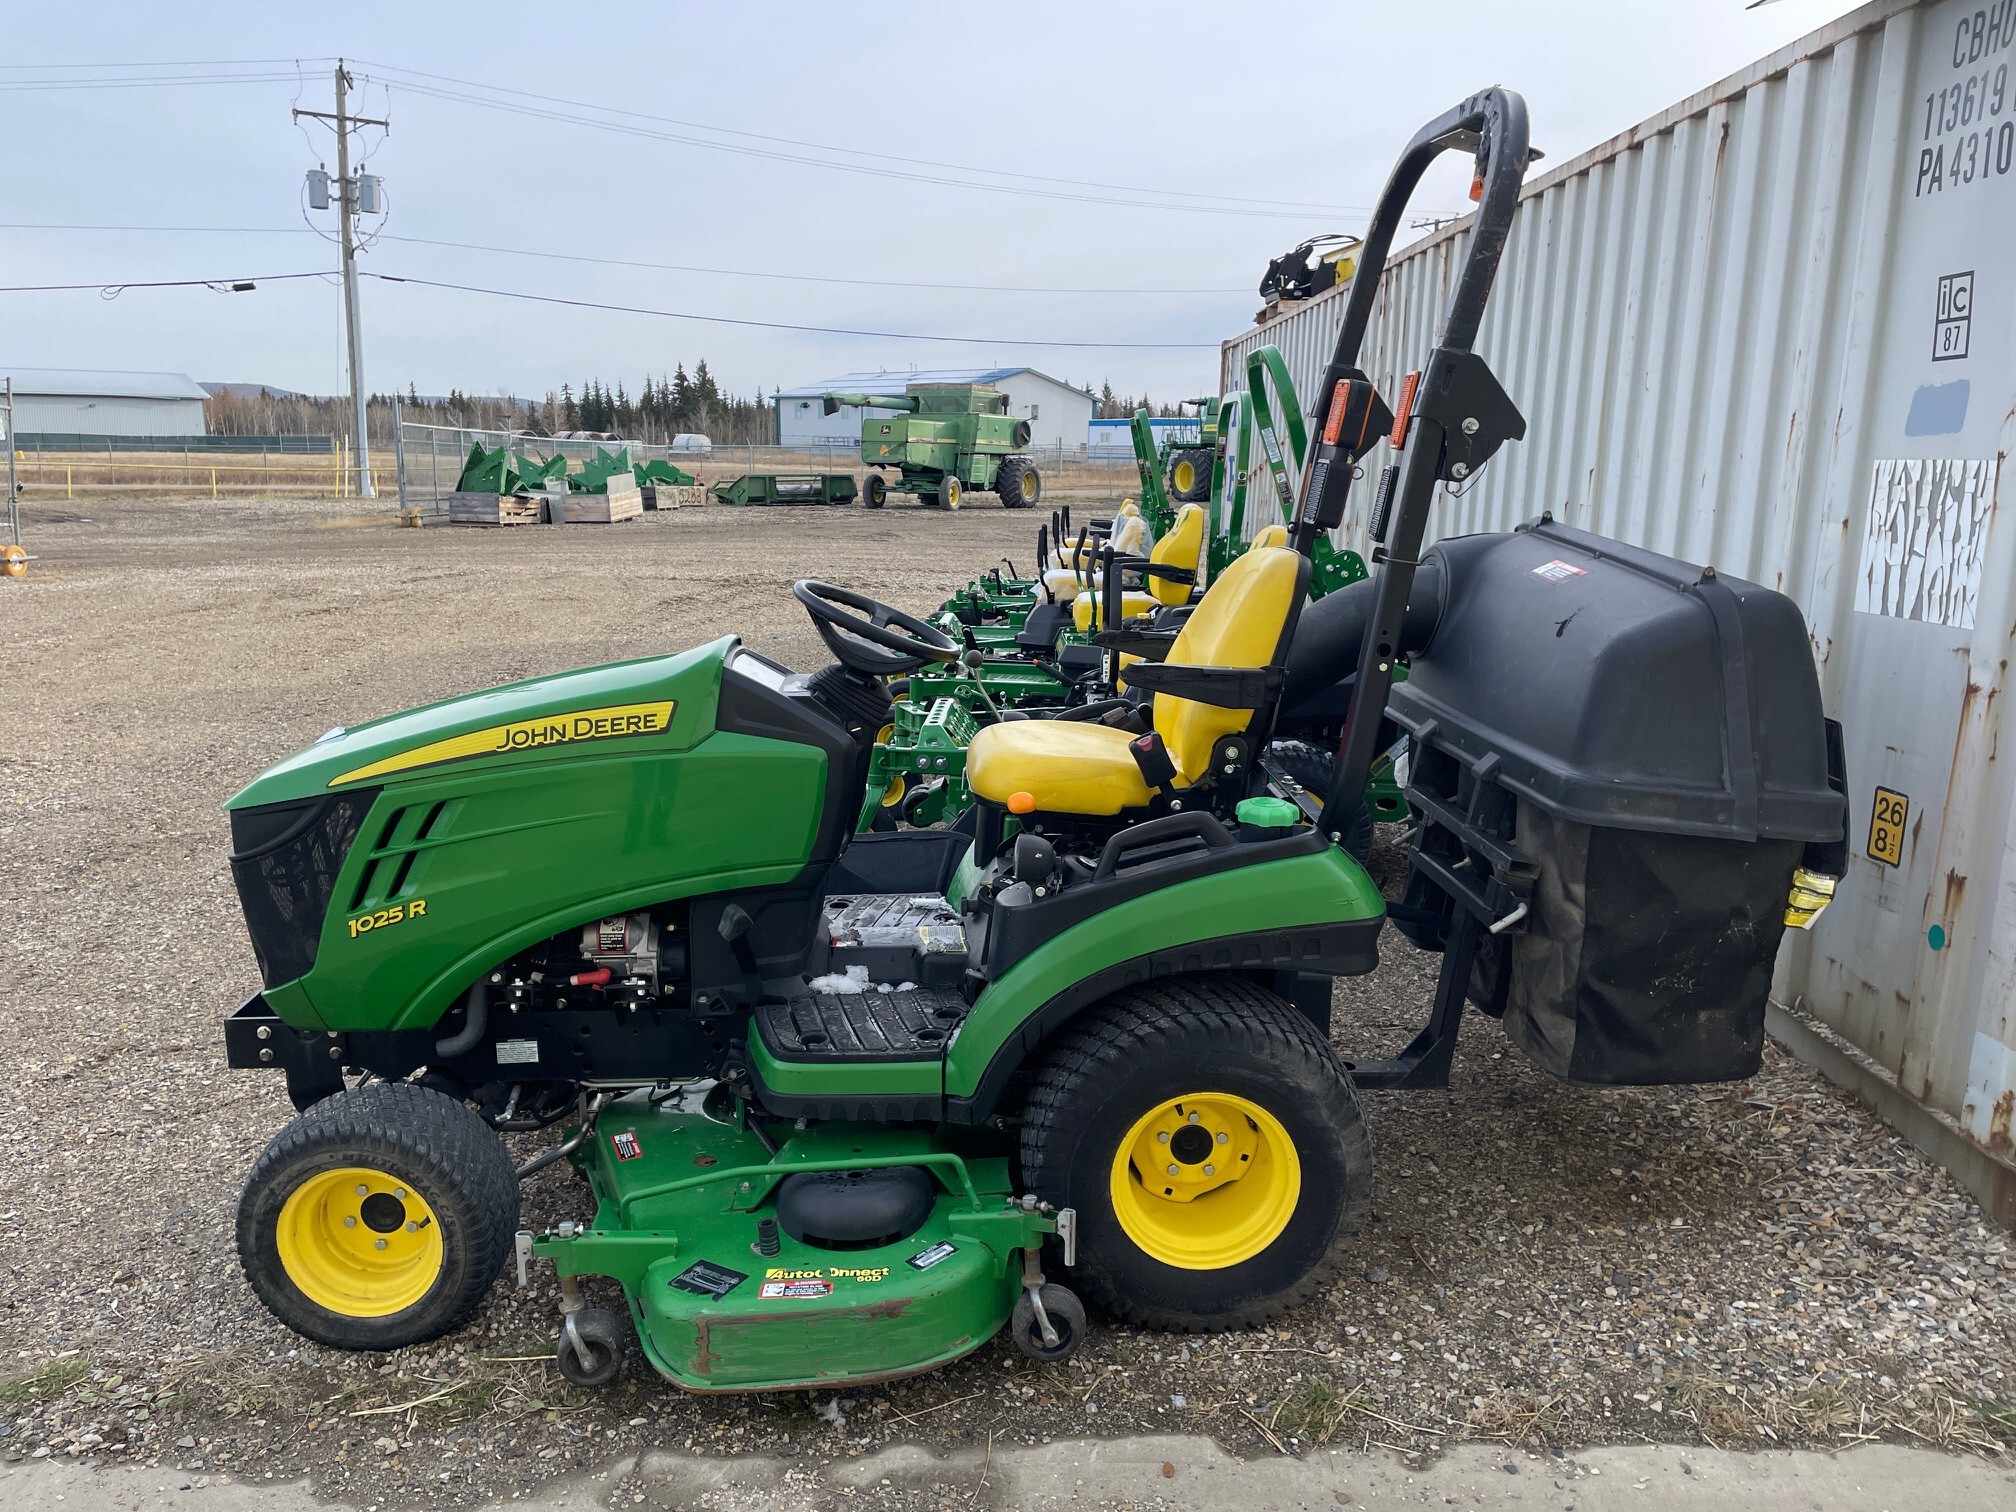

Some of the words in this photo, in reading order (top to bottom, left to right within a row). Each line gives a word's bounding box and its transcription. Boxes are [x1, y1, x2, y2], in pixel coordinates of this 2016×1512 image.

[1924, 63, 2008, 141] 113619
[1915, 144, 1944, 198] PA
[1949, 121, 2015, 188] 4310
[1943, 325, 1961, 352] 87
[496, 723, 567, 750] JOHN
[573, 713, 658, 737] DEERE
[348, 905, 404, 938] 1025
[409, 899, 427, 918] R
